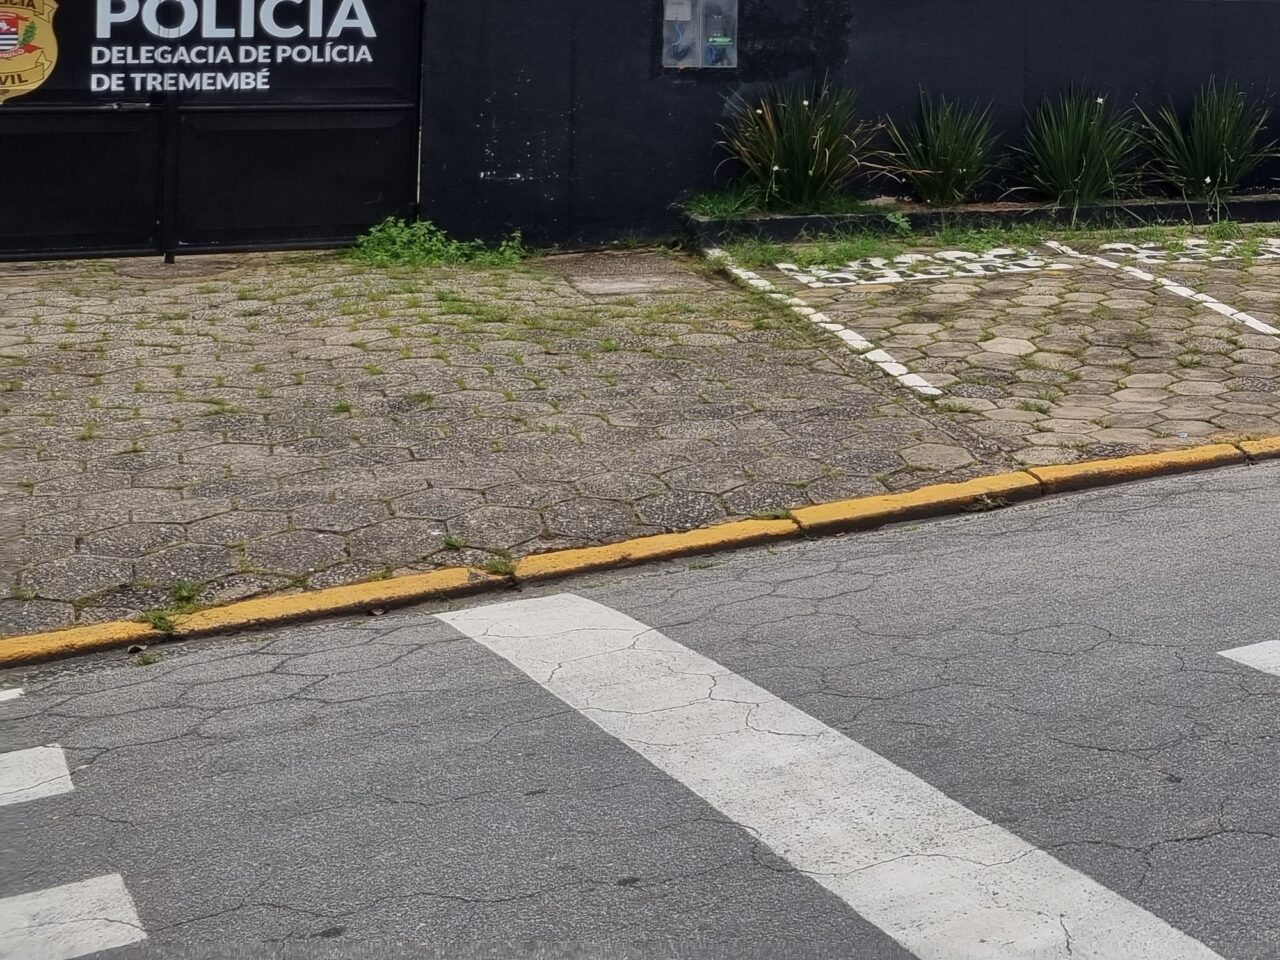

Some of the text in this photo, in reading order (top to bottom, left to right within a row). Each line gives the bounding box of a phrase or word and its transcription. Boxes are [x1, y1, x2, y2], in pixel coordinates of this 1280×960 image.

[91, 42, 374, 65] DELEGACIA DE POLÍCIA
[91, 68, 271, 92] DE TREMEMBÉ
